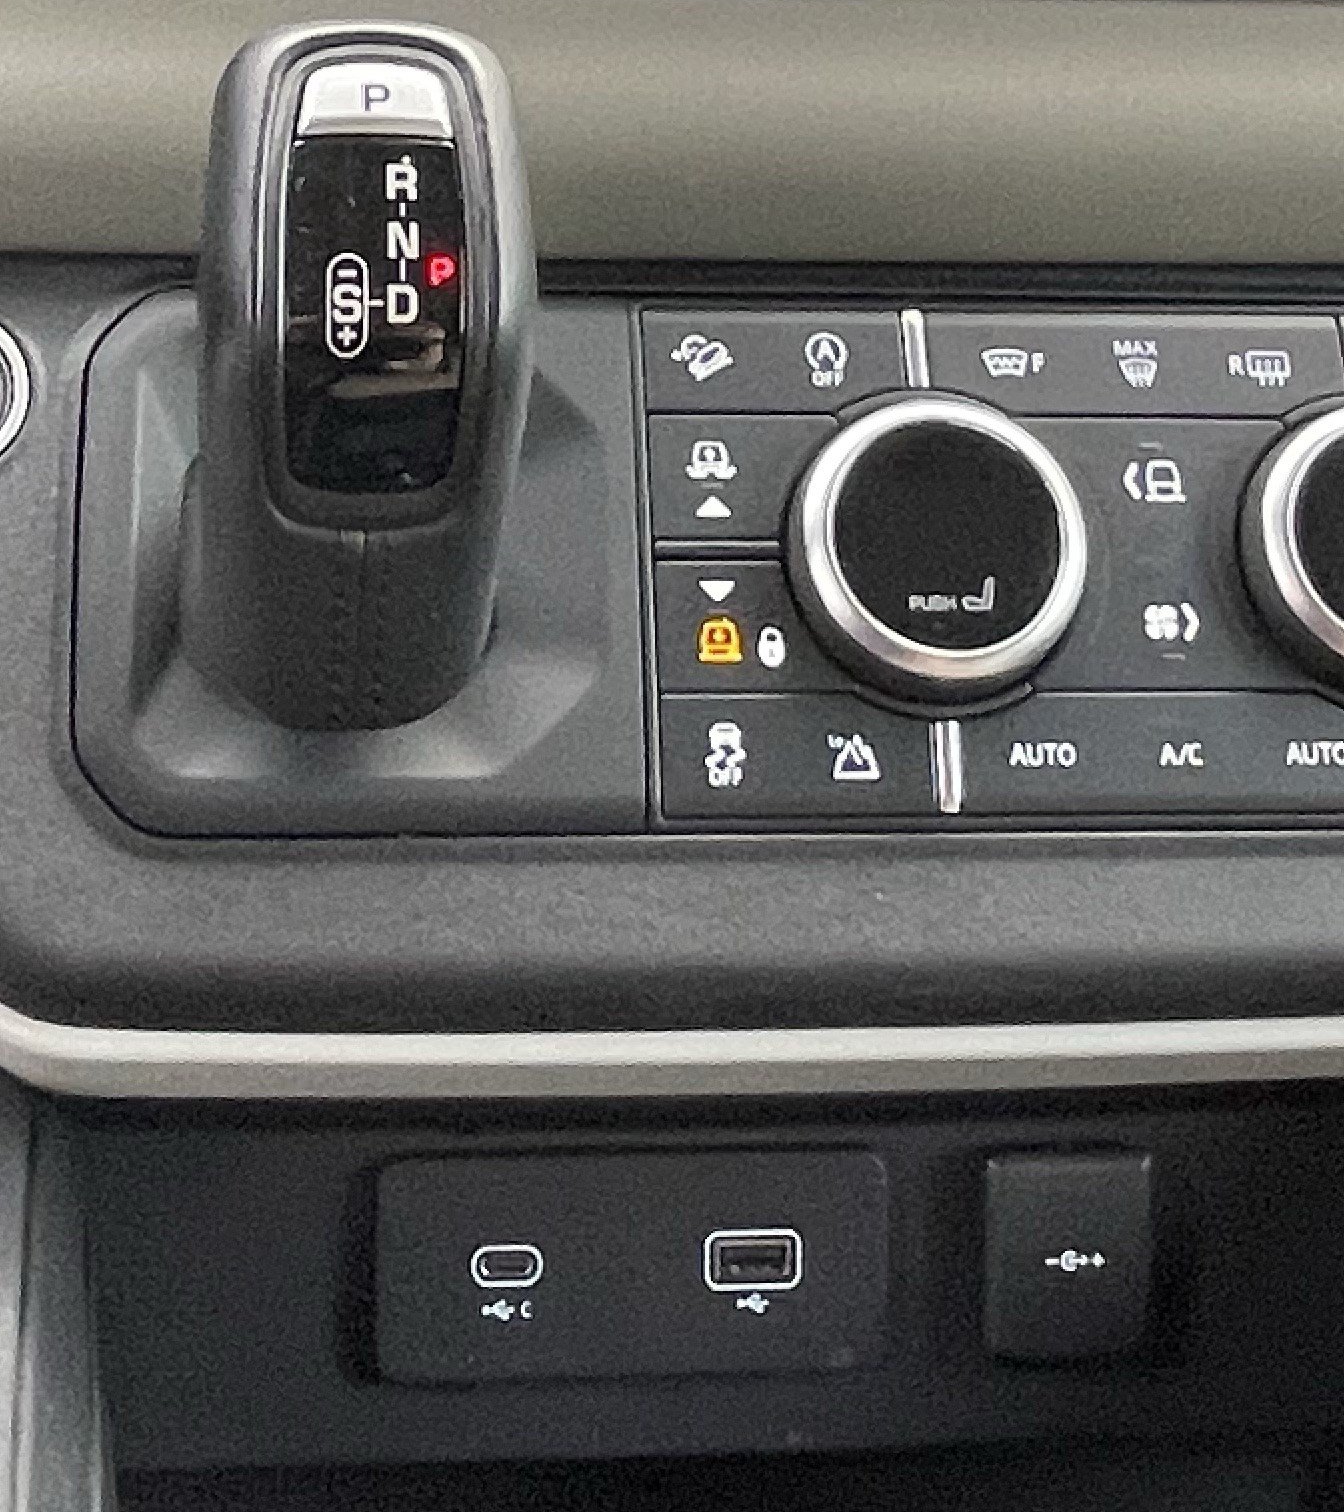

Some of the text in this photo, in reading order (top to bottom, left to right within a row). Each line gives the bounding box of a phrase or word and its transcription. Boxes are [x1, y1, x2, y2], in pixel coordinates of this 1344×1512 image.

[362, 84, 392, 114] P
[385, 162, 419, 203] R
[386, 220, 420, 259] N
[425, 256, 456, 285] P
[331, 281, 363, 324] S
[387, 284, 419, 325] D
[1113, 341, 1158, 357] MAX
[1228, 355, 1243, 376] R
[1009, 742, 1078, 767] AUTO
[1159, 742, 1204, 766] A/C
